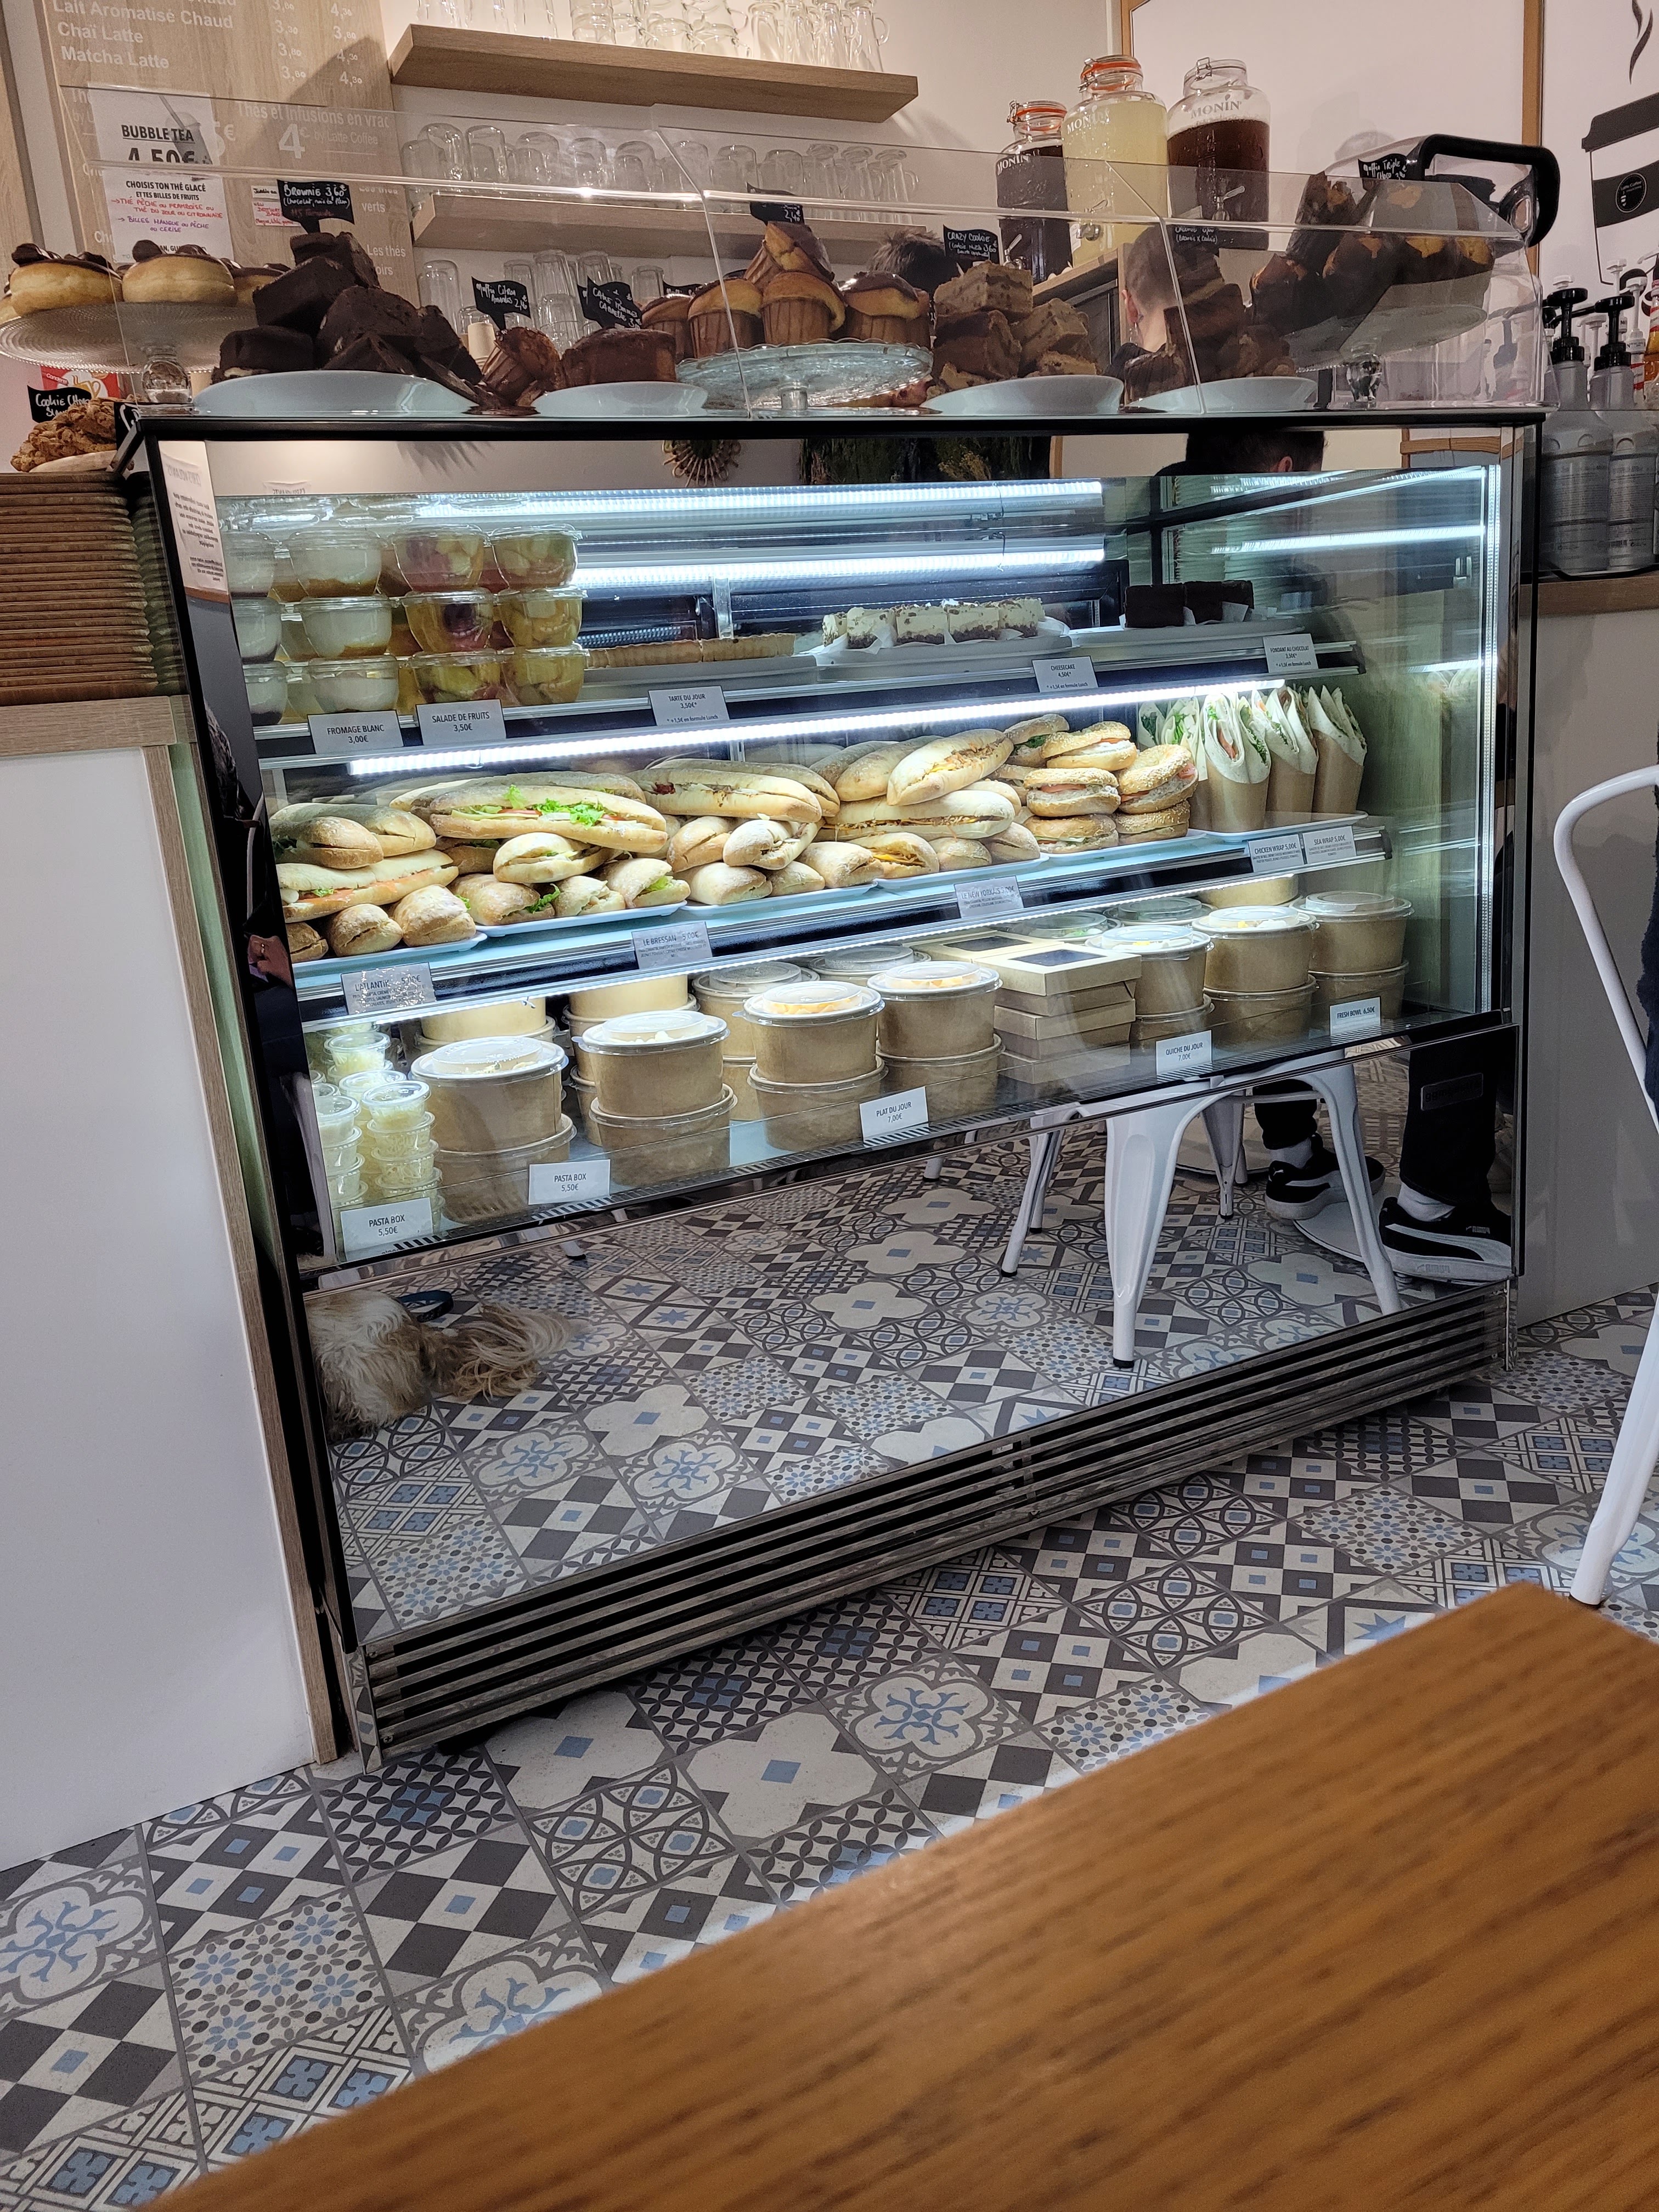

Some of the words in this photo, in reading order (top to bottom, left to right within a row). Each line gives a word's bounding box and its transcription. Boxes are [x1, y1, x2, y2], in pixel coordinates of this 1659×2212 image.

[90, 1, 176, 22] Aromatisé
[180, 10, 234, 29] Chaud
[330, 3, 352, 19] 4,30
[275, 20, 298, 35] 3,30
[333, 26, 356, 41] 3,80
[103, 26, 144, 43] Latte
[61, 46, 123, 65] Matcha
[128, 52, 170, 69] Latte
[278, 43, 302, 59] 3,80
[336, 49, 358, 65] 4,30
[281, 65, 306, 81] 3,80
[339, 71, 363, 87] 4,30
[347, 113, 362, 126] en
[121, 125, 170, 140] BUBBLE
[171, 128, 194, 142] TEA
[350, 131, 379, 145] Coffee
[126, 180, 154, 189] CHOISIS
[155, 182, 170, 190] TON
[170, 181, 184, 190] THÉ
[184, 183, 206, 192] GLACÉ
[120, 196, 133, 205] THÉ
[362, 202, 385, 213] verts
[367, 244, 383, 256] Les
[386, 245, 406, 257] thés
[376, 264, 393, 275] oirs
[36, 393, 65, 407] Cookie
[432, 714, 457, 723] SALADE
[458, 713, 467, 721] DE
[468, 712, 490, 720] FRUITS
[327, 725, 361, 735] FROMAGE
[362, 724, 385, 733] BLANC
[453, 723, 473, 732] 3,50€
[347, 735, 369, 744] 3,00€
[1254, 847, 1272, 855] CHICKEN
[1285, 842, 1297, 850] 5,00€
[651, 934, 676, 945] BRESSAN
[1166, 1046, 1183, 1055] QUICHE
[1178, 1053, 1191, 1061] 7,00€
[876, 1108, 888, 1117] PLAT
[898, 1102, 911, 1111] JOUR
[887, 1113, 902, 1123] 7,00€
[561, 1183, 579, 1192] 5,50€
[369, 1217, 390, 1227] PASTA
[391, 1215, 405, 1224] BOX
[378, 1226, 398, 1237] 5,50€
